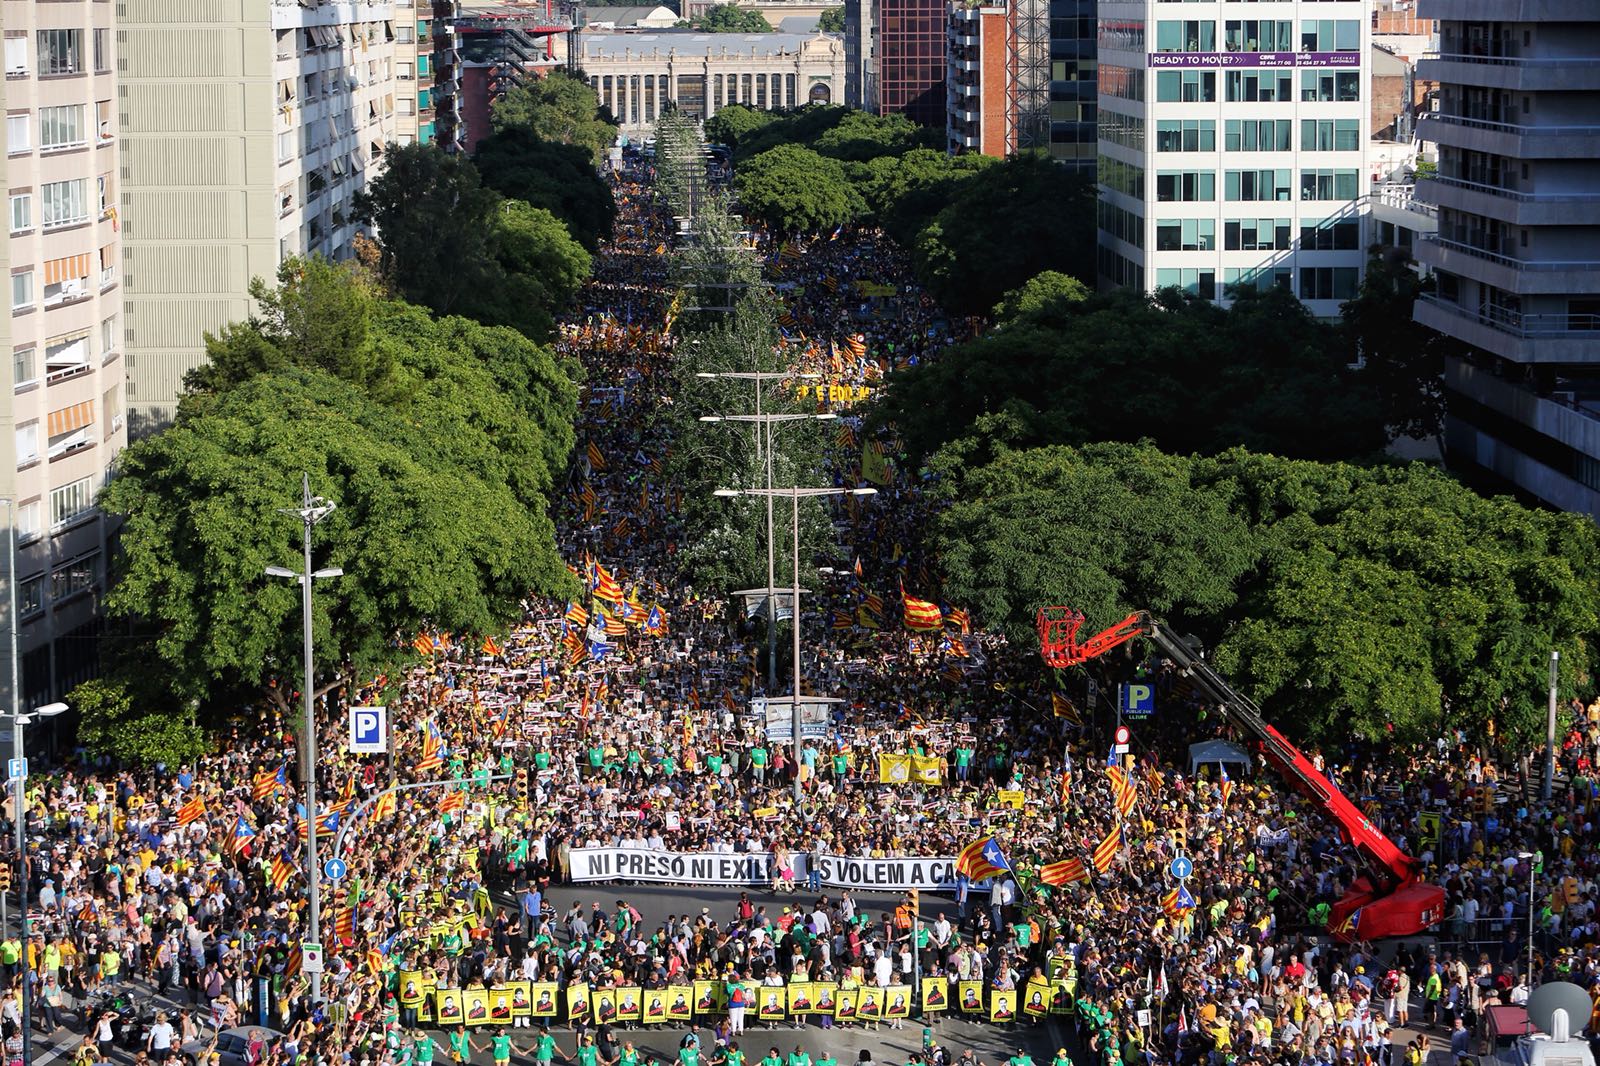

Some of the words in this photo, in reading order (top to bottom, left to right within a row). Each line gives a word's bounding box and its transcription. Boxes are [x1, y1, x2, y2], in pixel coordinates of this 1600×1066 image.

[1153, 56, 1184, 64] READY
[1187, 56, 1199, 64] TO
[1202, 56, 1233, 64] MOVE?
[1129, 685, 1150, 709] P
[357, 713, 377, 739] P
[588, 854, 609, 875] NI
[616, 853, 684, 877] PRESÓ
[691, 859, 713, 879] NI
[837, 860, 904, 884] VOLEM
[911, 863, 925, 884] A
